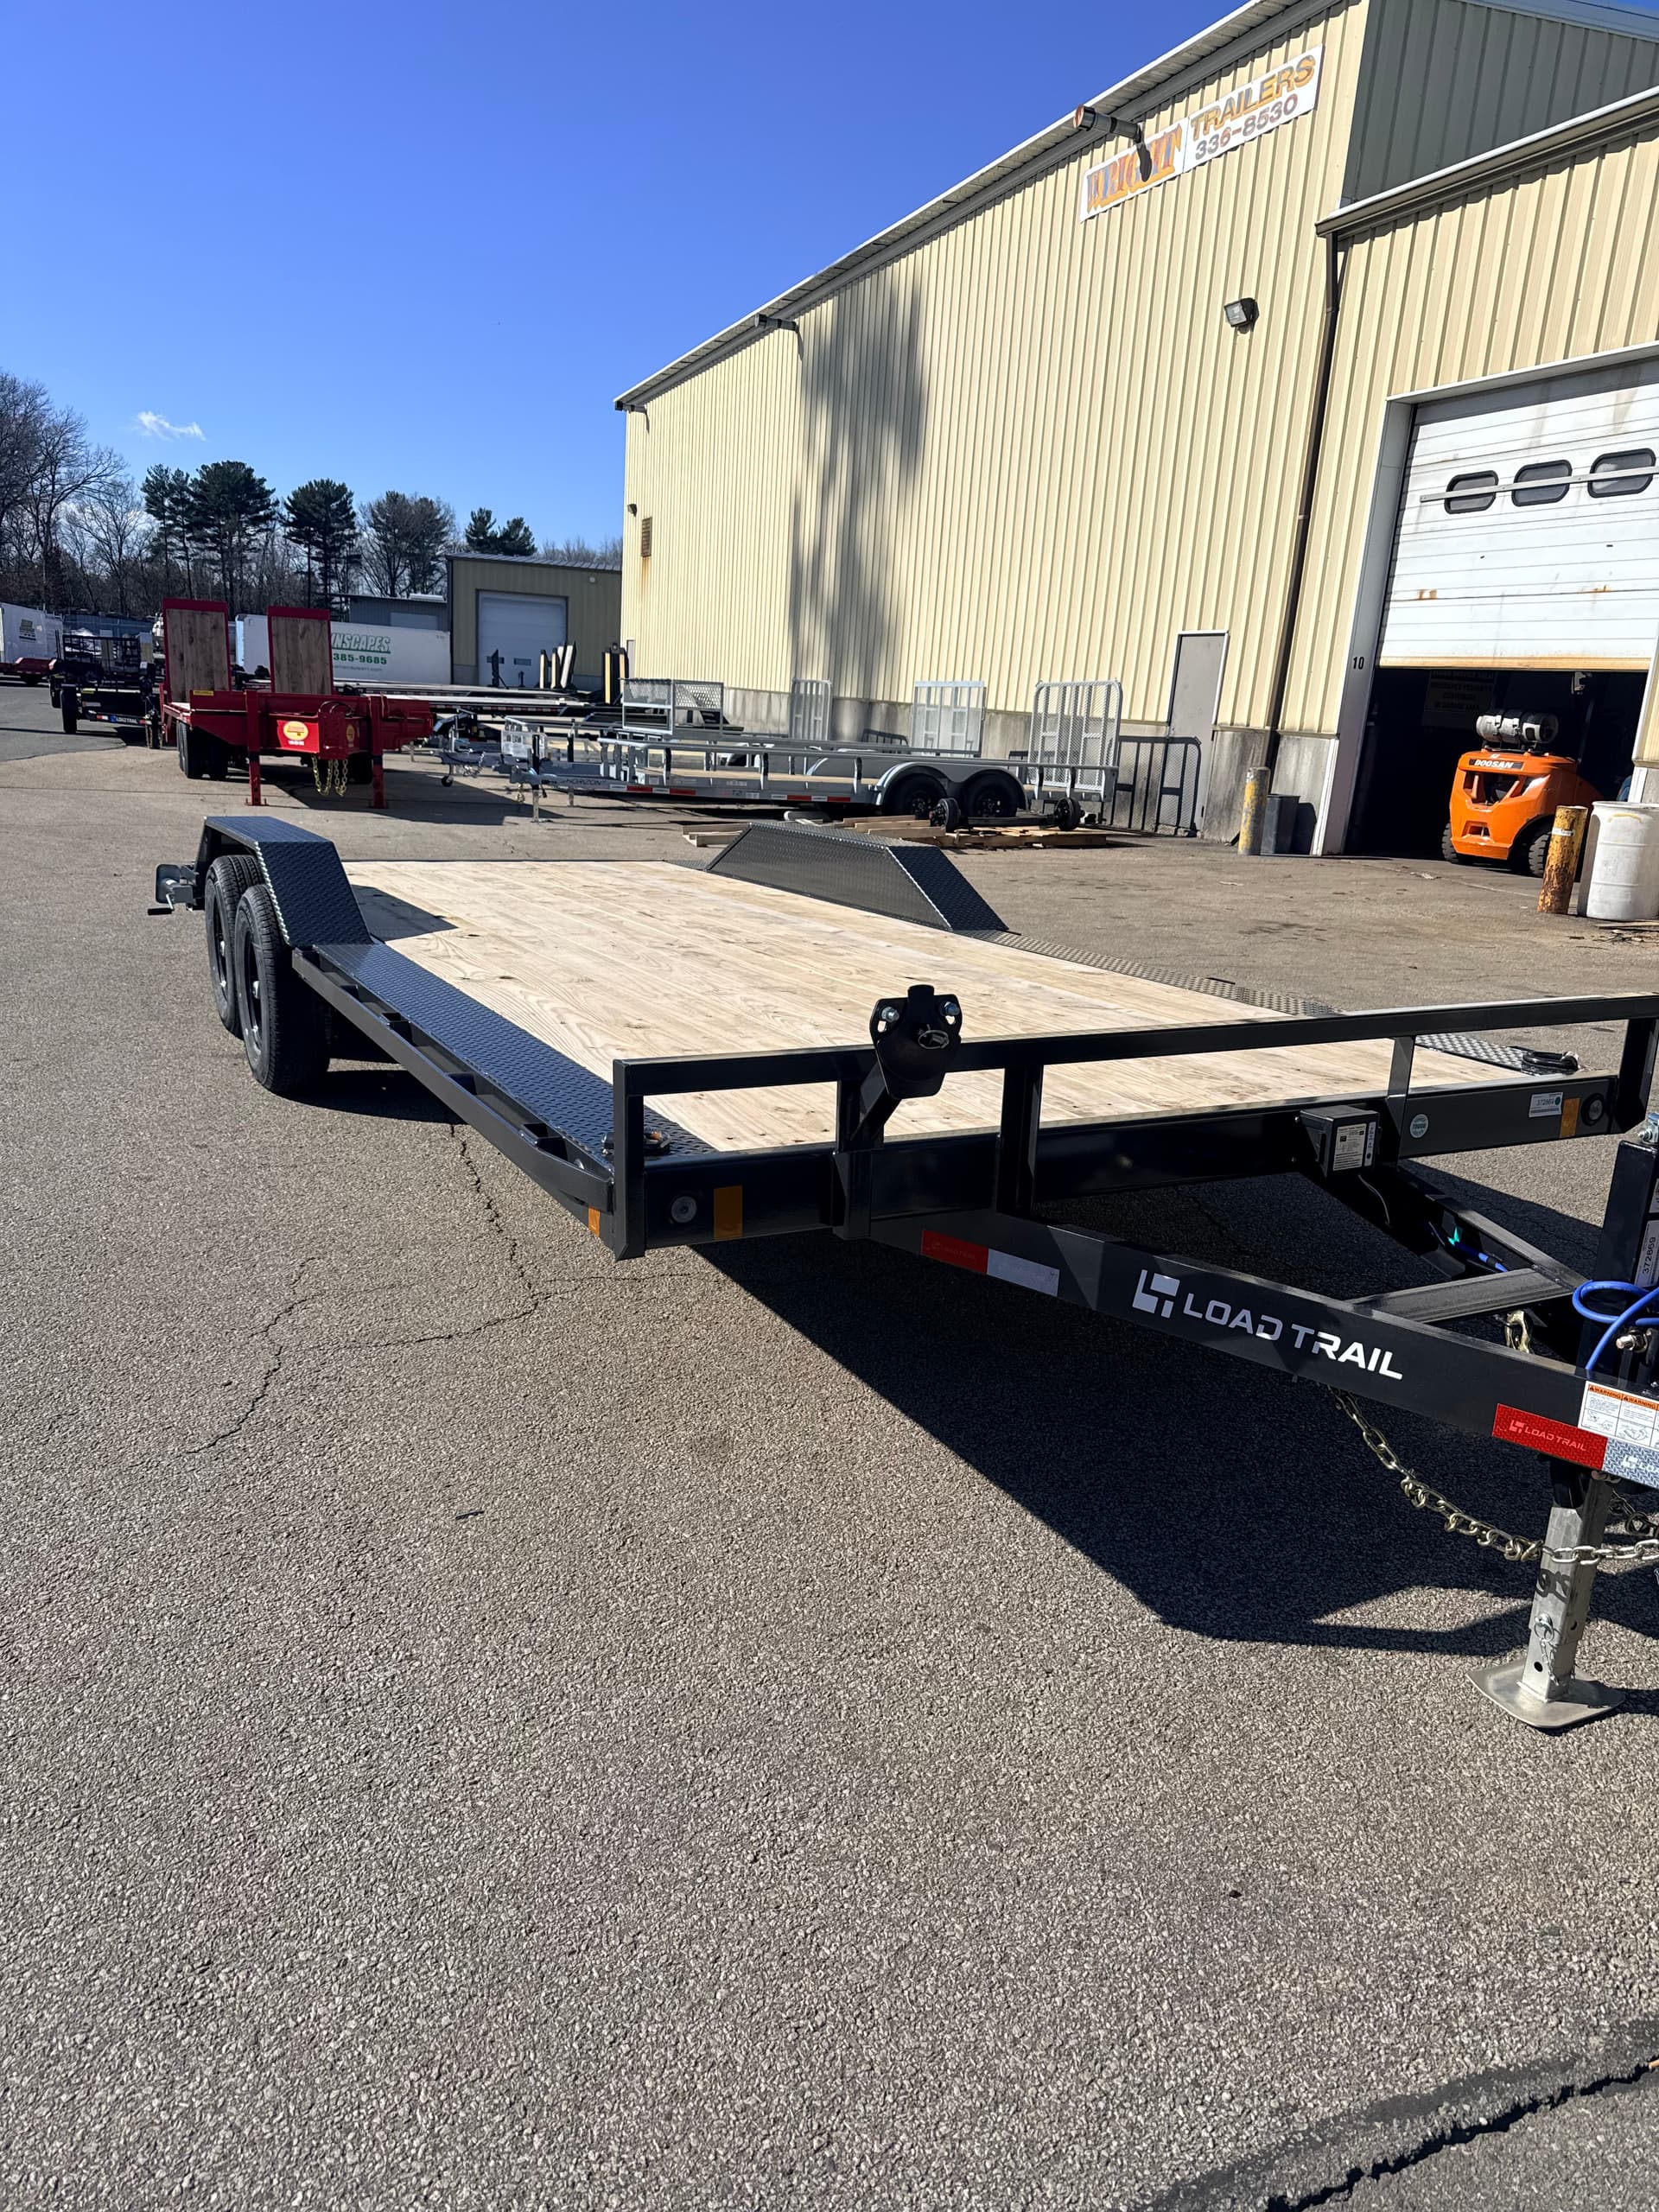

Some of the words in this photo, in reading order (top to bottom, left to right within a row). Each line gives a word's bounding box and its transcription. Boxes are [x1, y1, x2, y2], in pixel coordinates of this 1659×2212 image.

[1191, 54, 1316, 142] TRAILERS
[1195, 93, 1298, 161] 336-8530
[332, 632, 391, 652] NSCAPES
[334, 653, 387, 664] 385-9685
[1353, 657, 1364, 670] 10
[1474, 760, 1514, 768] DOOSAN
[1183, 1293, 1283, 1341] LOAD
[1291, 1323, 1403, 1381] TRAIL
[1594, 1388, 1621, 1399] WARNING
[1629, 1397, 1656, 1409] WARNING
[1525, 1426, 1554, 1441] LOAD
[1555, 1436, 1587, 1452] TRAIL
